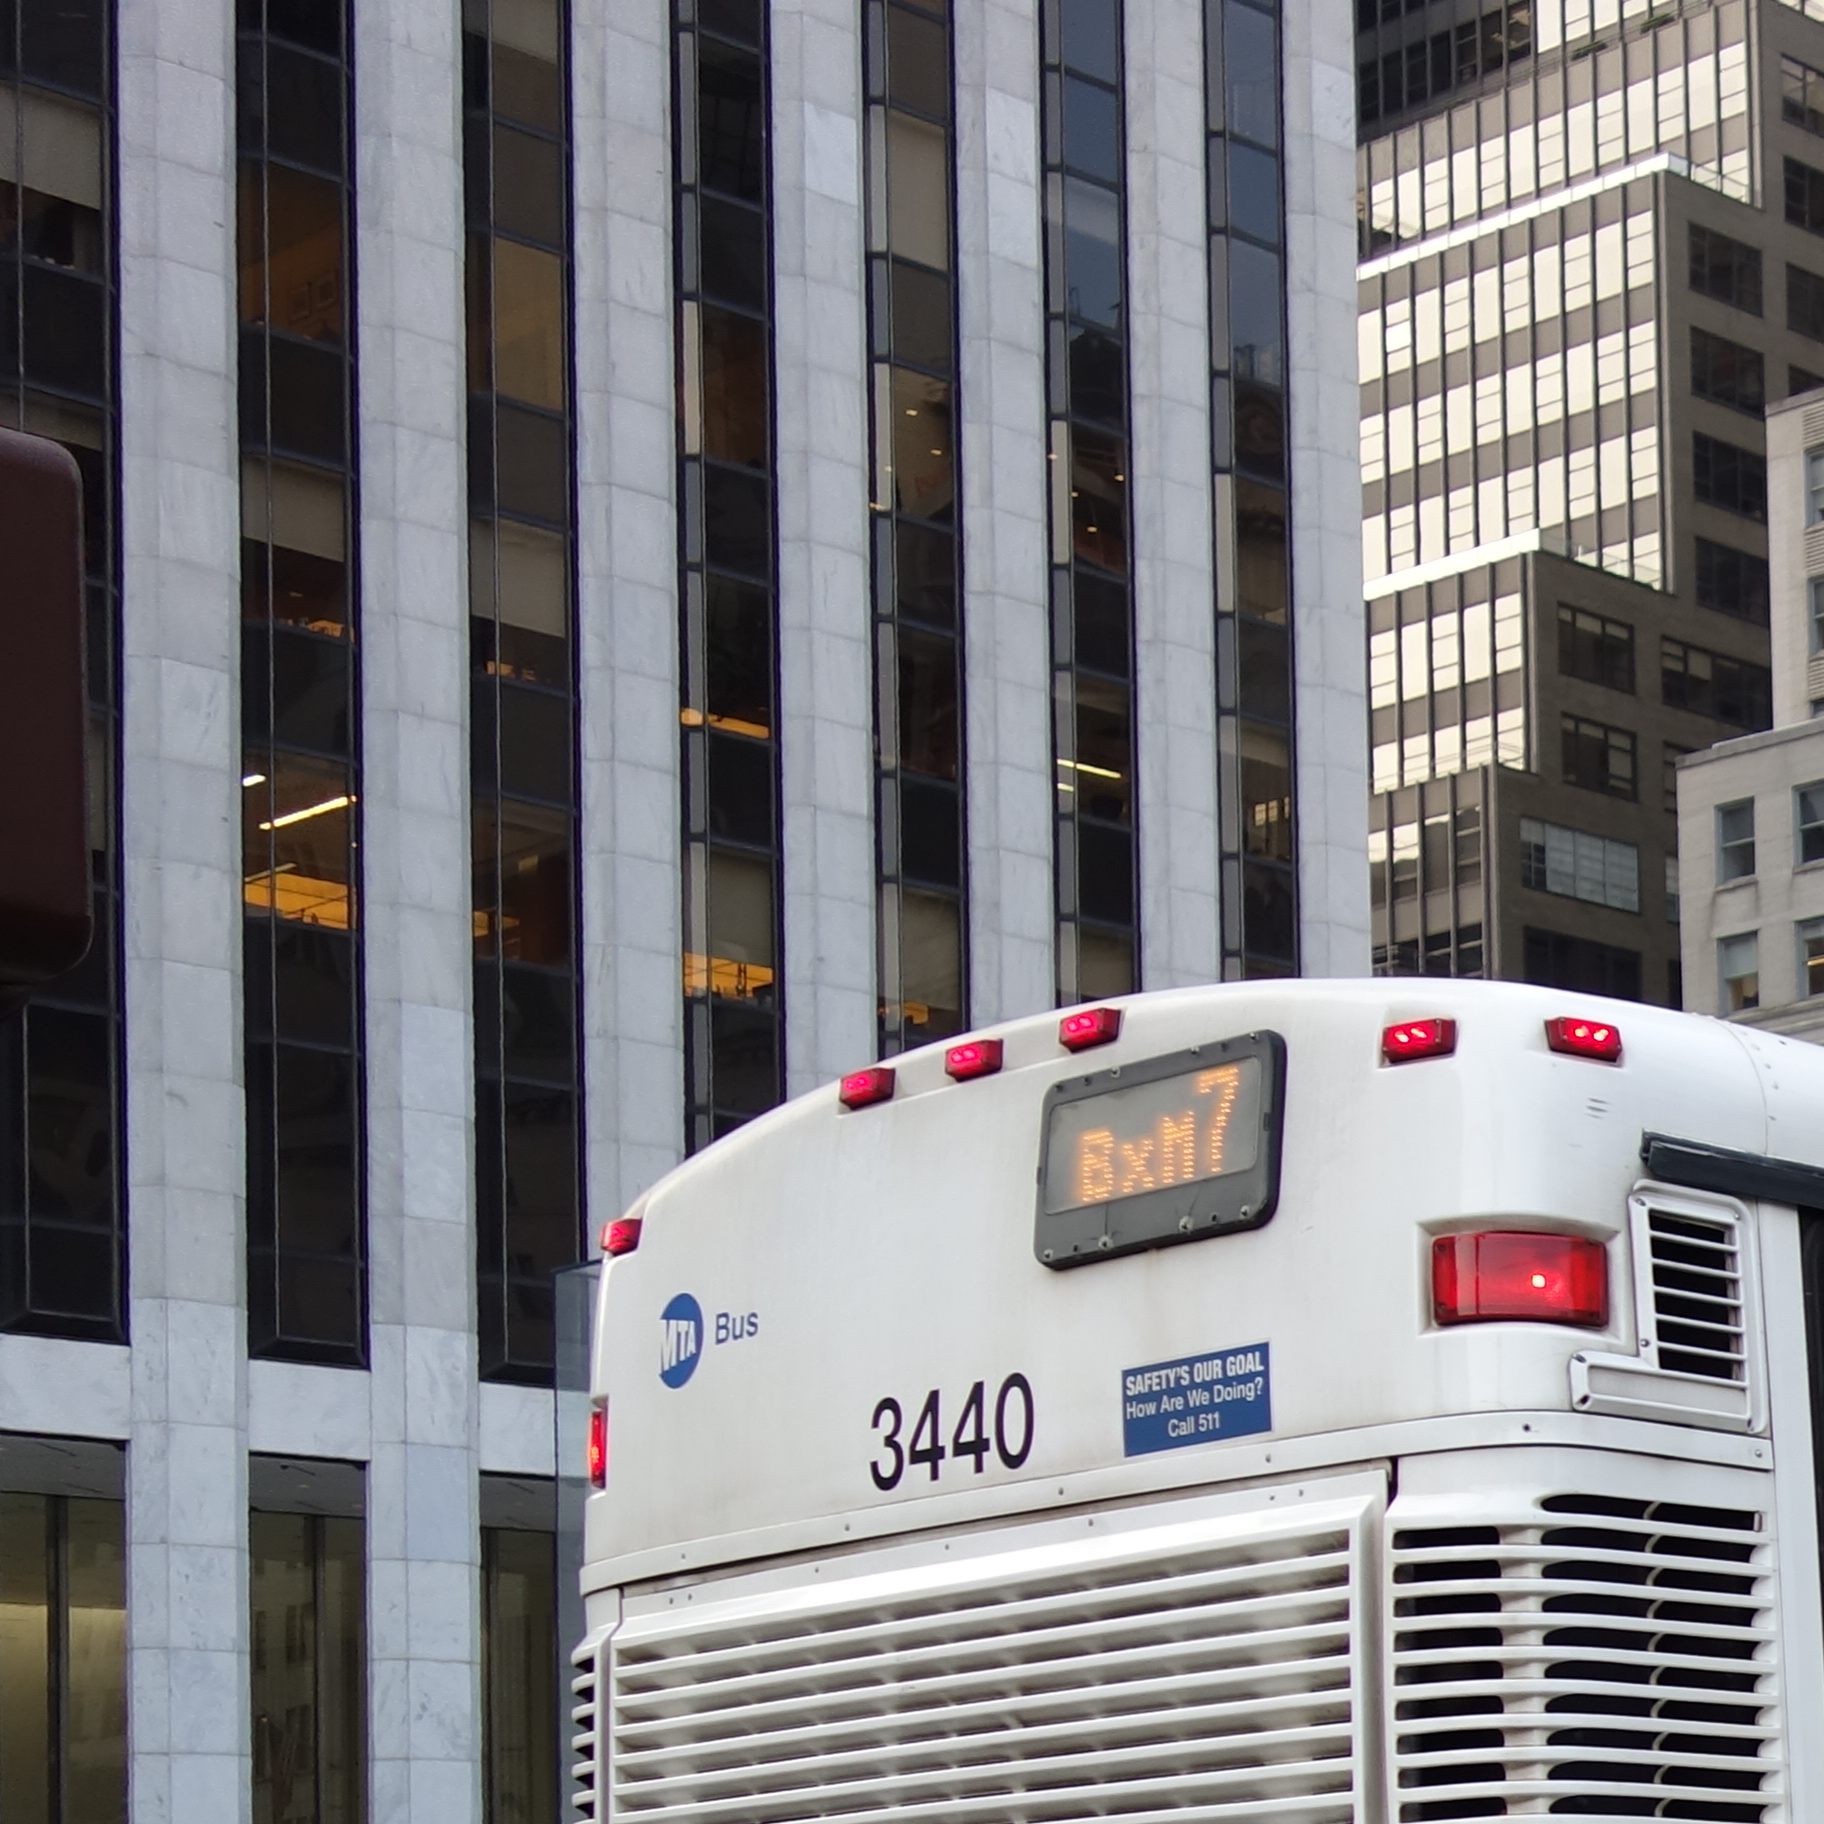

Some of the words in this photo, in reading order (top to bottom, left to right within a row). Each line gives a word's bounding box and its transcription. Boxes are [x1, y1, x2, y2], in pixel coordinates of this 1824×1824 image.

[1082, 1066, 1240, 1202] BxM7
[659, 1319, 697, 1374] MTA
[715, 1312, 759, 1345] Bus
[1126, 1365, 1190, 1396] SAFETY'S
[1193, 1359, 1223, 1383] OUR
[1226, 1351, 1265, 1377] GOAL
[1126, 1401, 1156, 1420] How
[1160, 1395, 1184, 1413] Are
[1187, 1388, 1210, 1408] We
[1213, 1376, 1264, 1403] Doing?
[869, 1372, 1034, 1491] 3440
[1168, 1416, 1195, 1438] Call
[1198, 1411, 1220, 1432] 511
